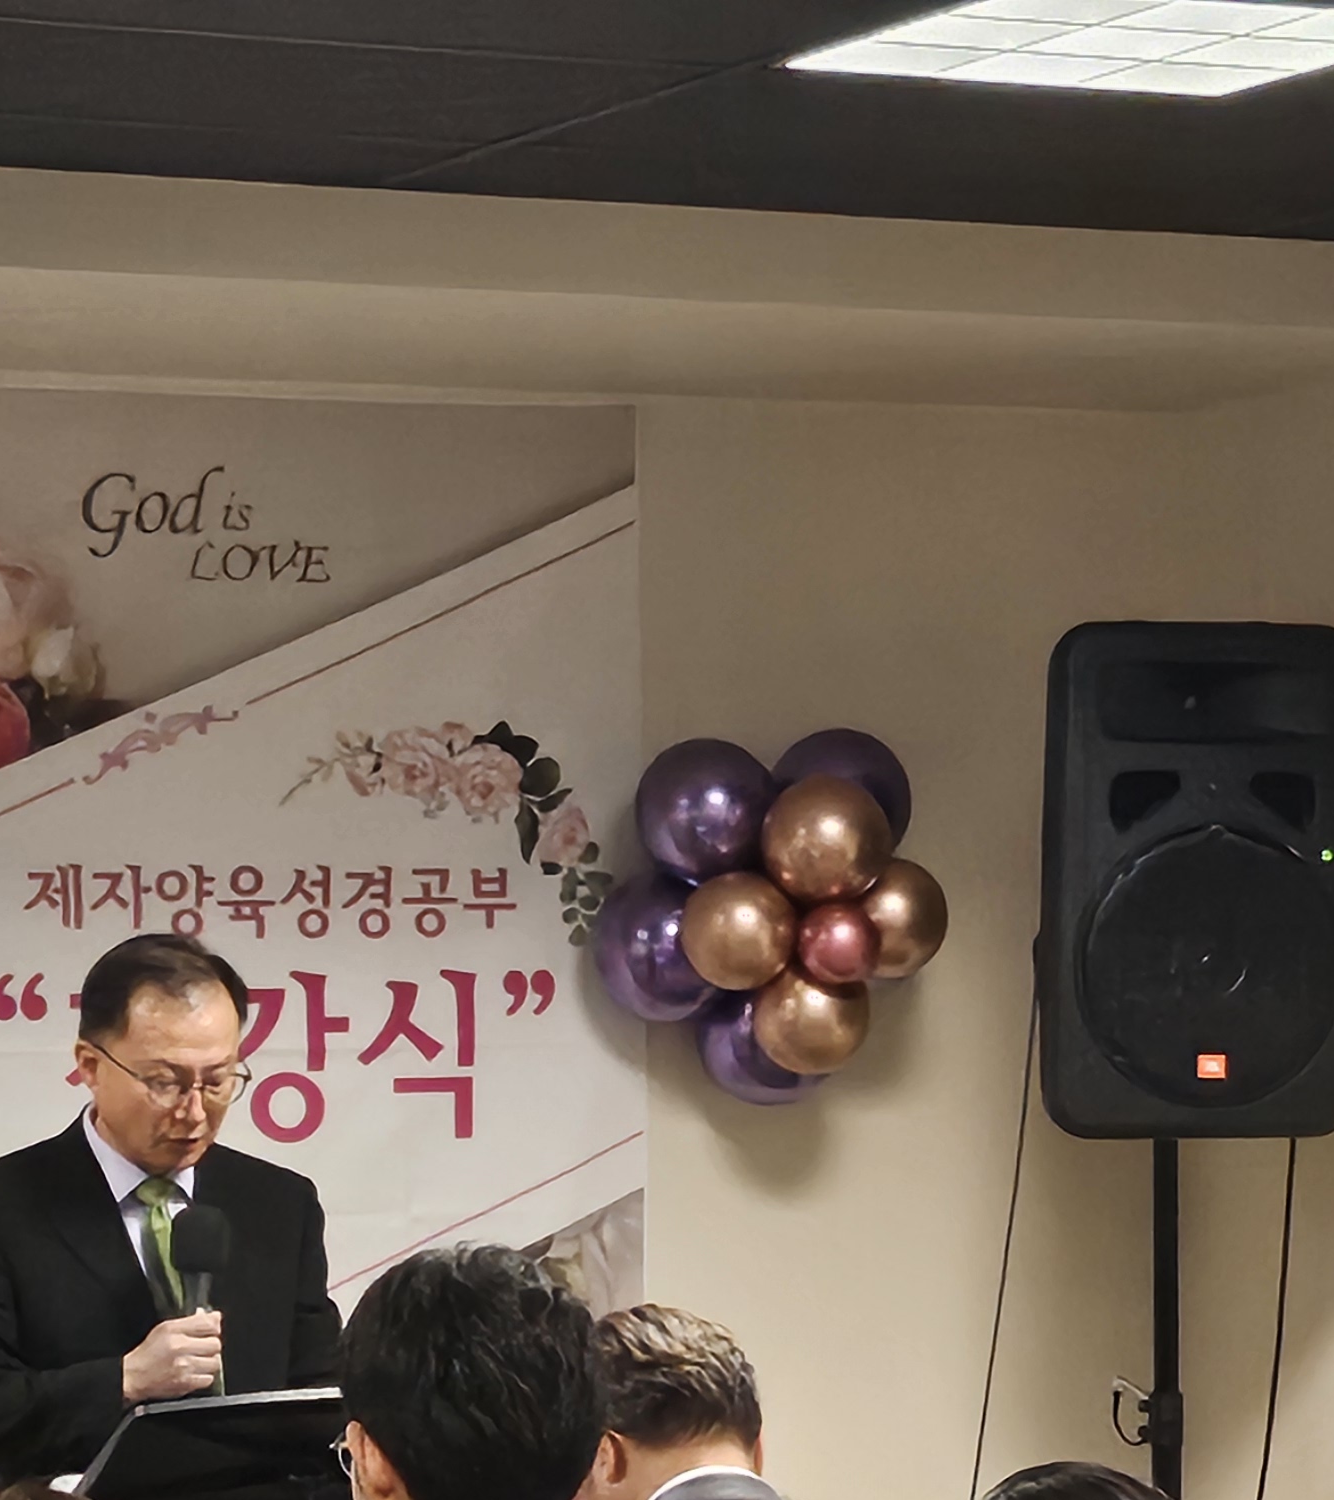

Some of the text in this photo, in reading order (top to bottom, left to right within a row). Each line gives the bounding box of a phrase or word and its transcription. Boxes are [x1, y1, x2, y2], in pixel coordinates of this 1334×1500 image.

[82, 466, 254, 558] God is
[190, 540, 331, 583] LOVE
[23, 864, 518, 939] 제자양육성경공부
